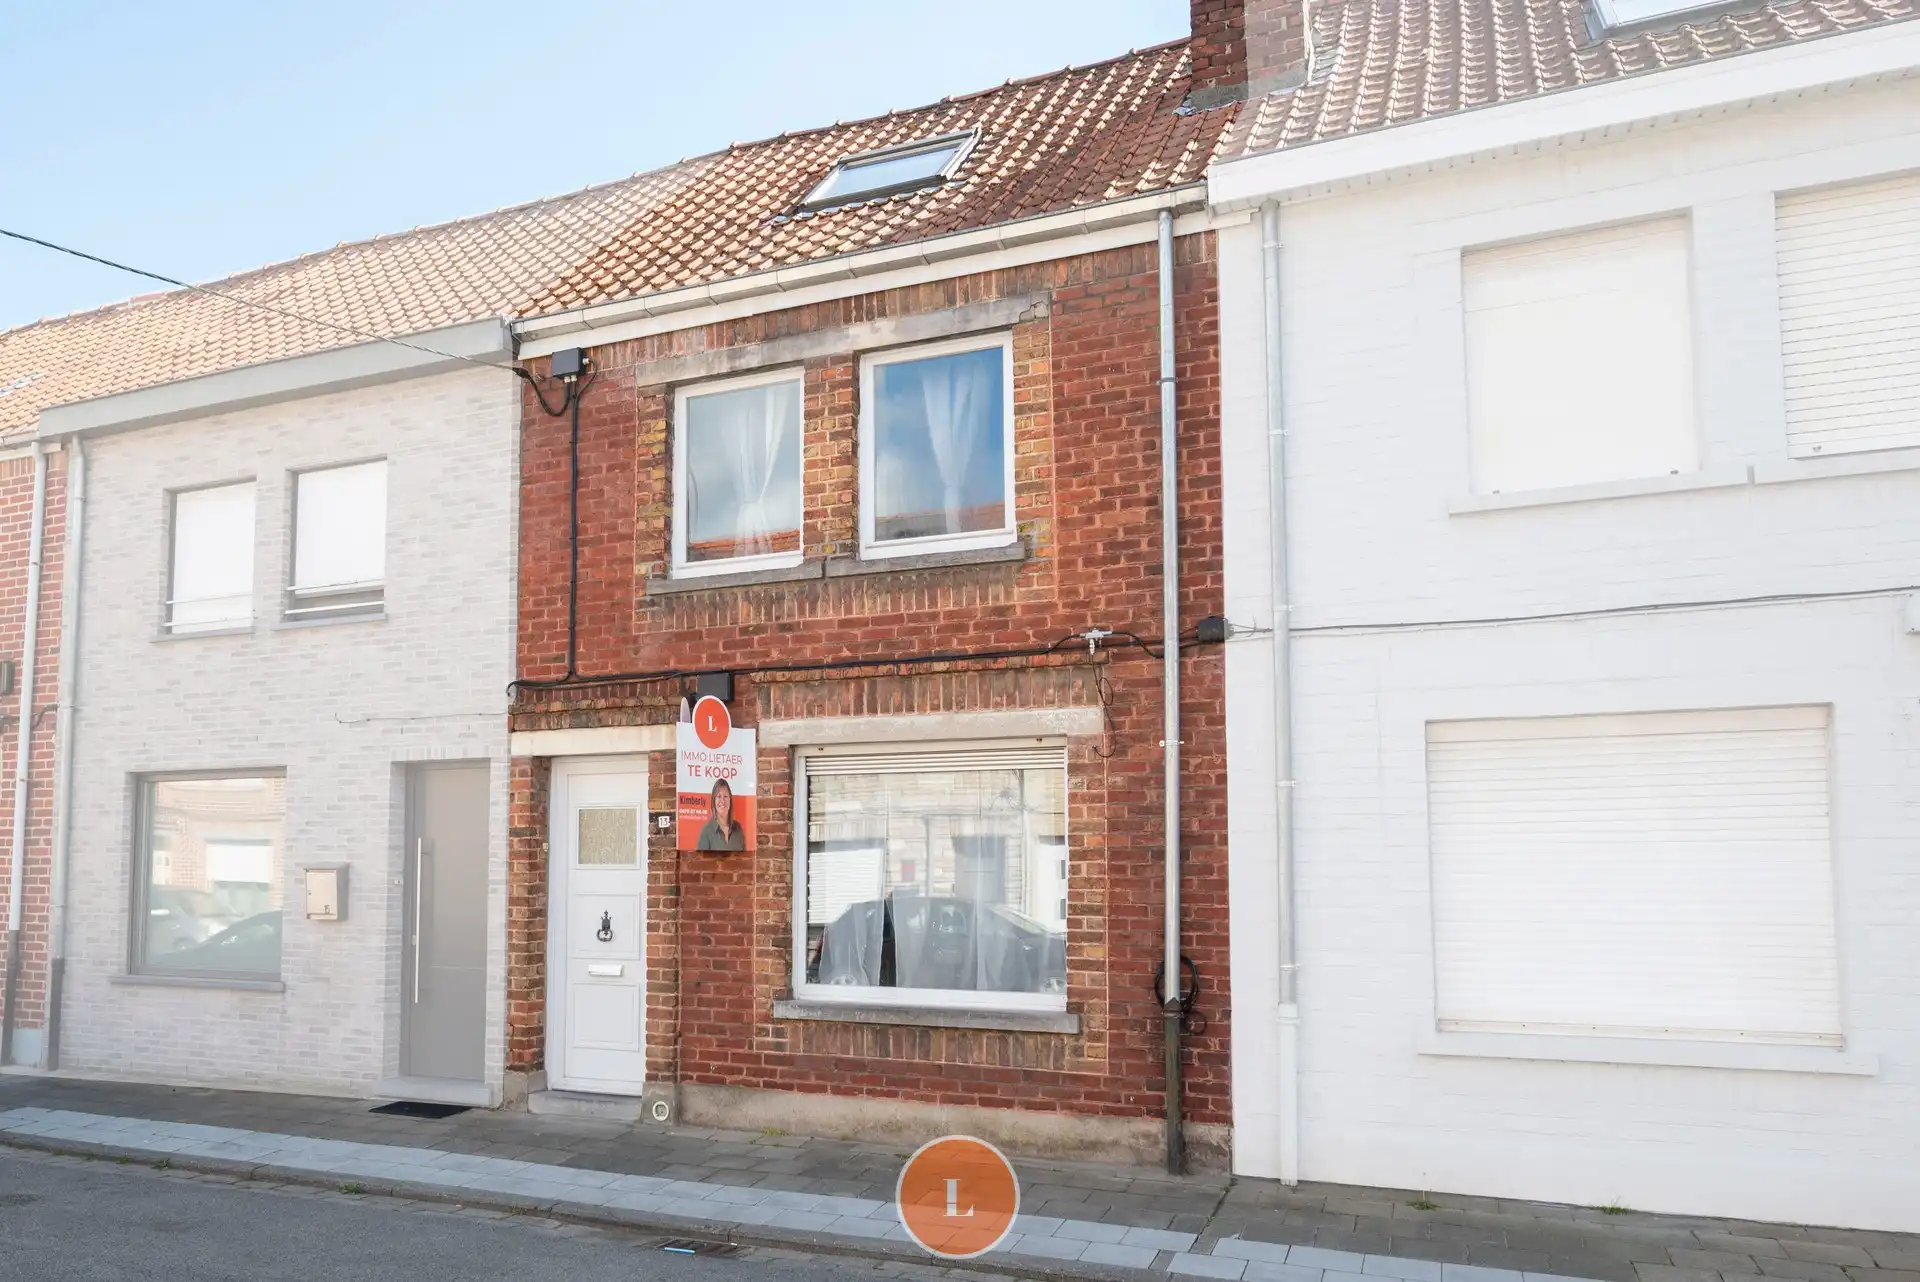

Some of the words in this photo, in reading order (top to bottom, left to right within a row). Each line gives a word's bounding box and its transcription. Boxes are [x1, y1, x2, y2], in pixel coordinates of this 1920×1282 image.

[708, 715, 717, 732] L
[682, 751, 706, 762] IMMO
[709, 753, 742, 764] LIETAER
[688, 764, 701, 777] TE
[705, 766, 738, 779] KOOP
[679, 795, 707, 807] Kimberly
